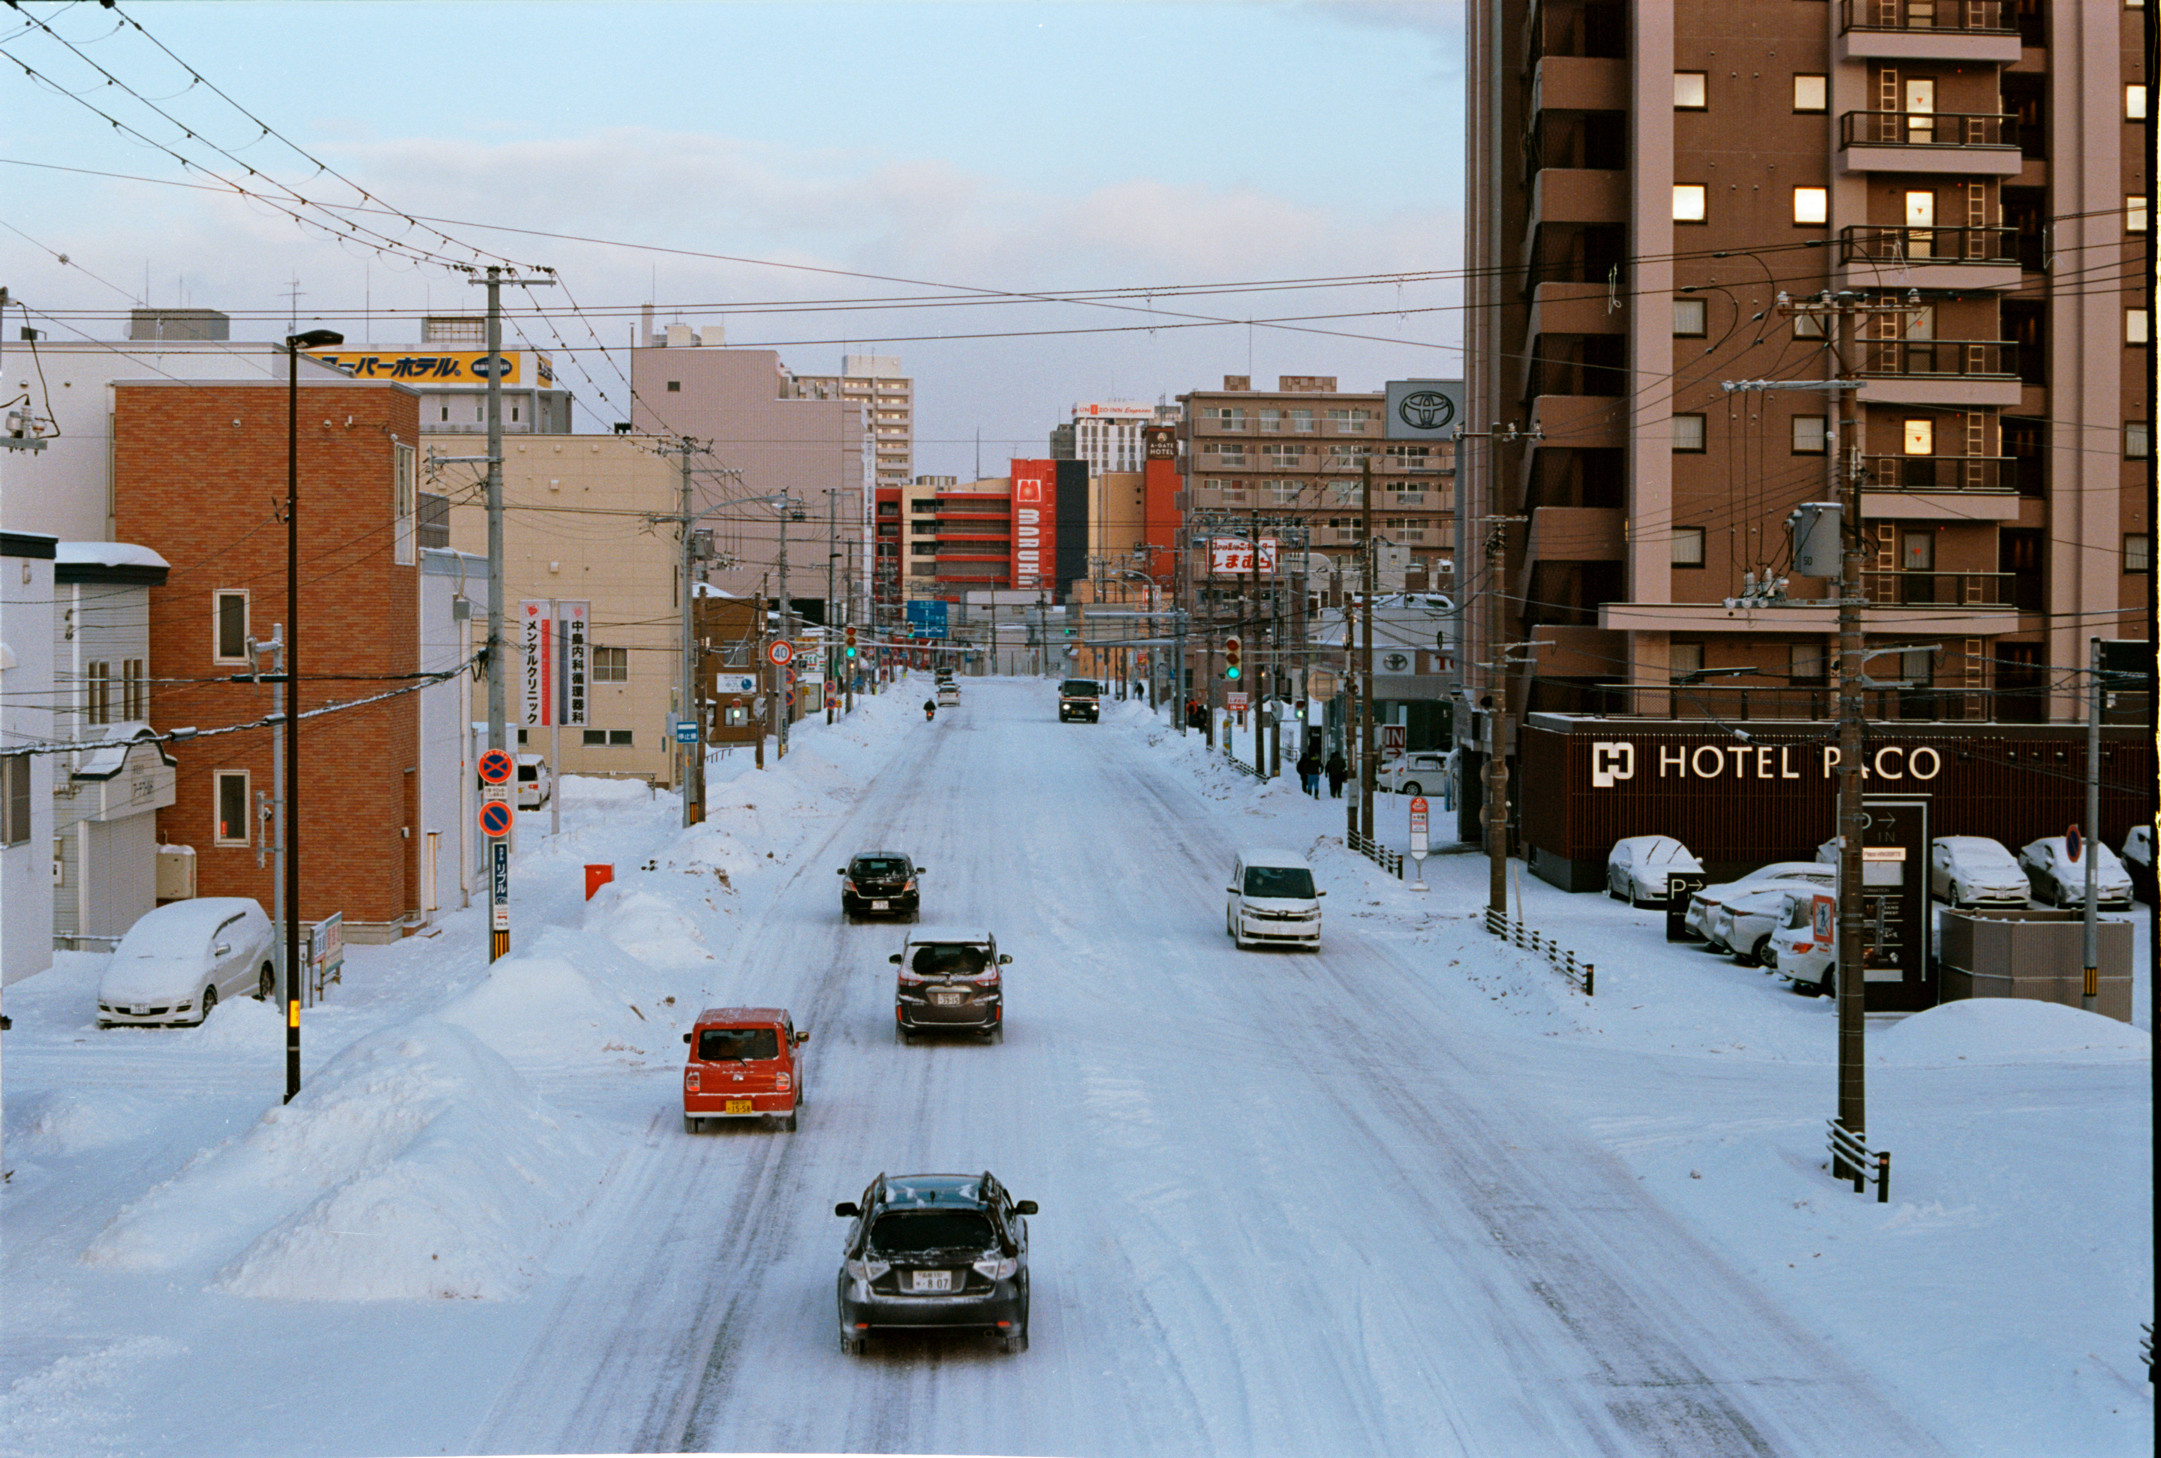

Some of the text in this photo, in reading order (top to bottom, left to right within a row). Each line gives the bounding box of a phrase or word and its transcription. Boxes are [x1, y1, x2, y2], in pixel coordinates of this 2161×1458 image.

[1018, 508, 1040, 590] MARUHA
[774, 647, 788, 659] 40
[526, 620, 539, 725] メンタルクリニック
[1386, 728, 1404, 746] IN
[1659, 745, 1942, 780] HOTEL PCO
[1671, 878, 1687, 900] P
